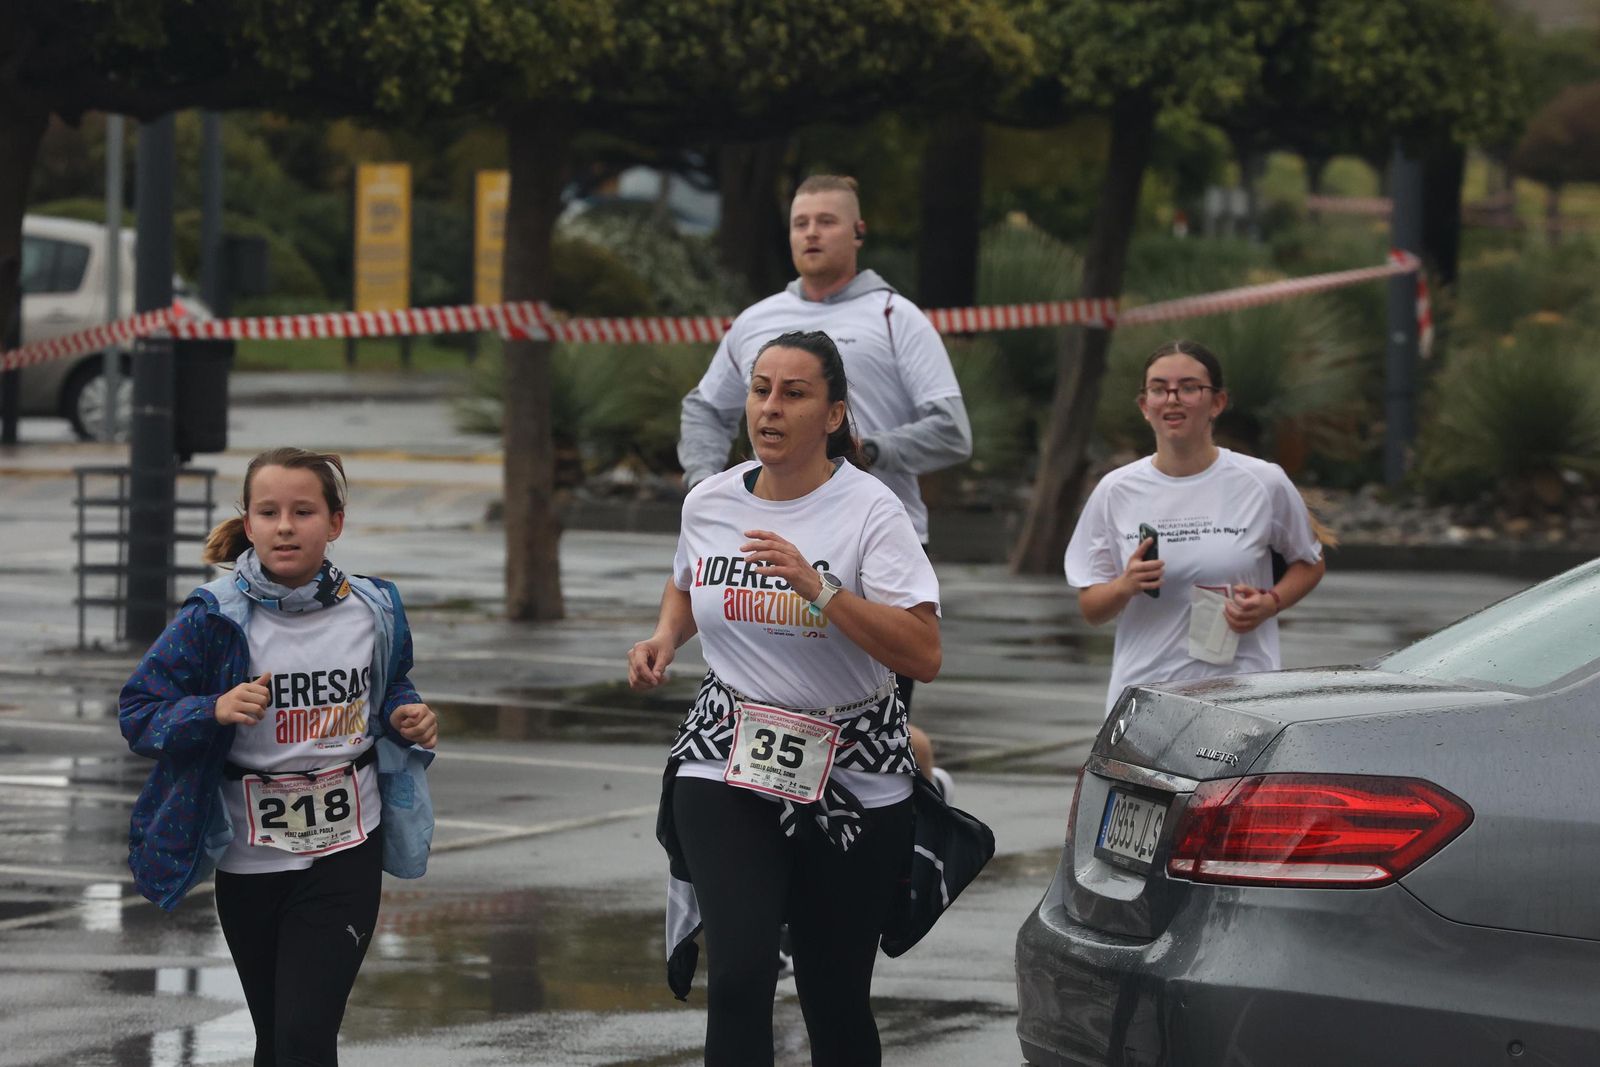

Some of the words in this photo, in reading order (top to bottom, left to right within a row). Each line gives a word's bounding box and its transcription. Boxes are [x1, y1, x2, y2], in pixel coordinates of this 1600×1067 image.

[751, 728, 807, 769] 35
[1196, 748, 1239, 767] BLUETEC
[259, 788, 351, 829] 218
[1107, 797, 1141, 850] 0955
